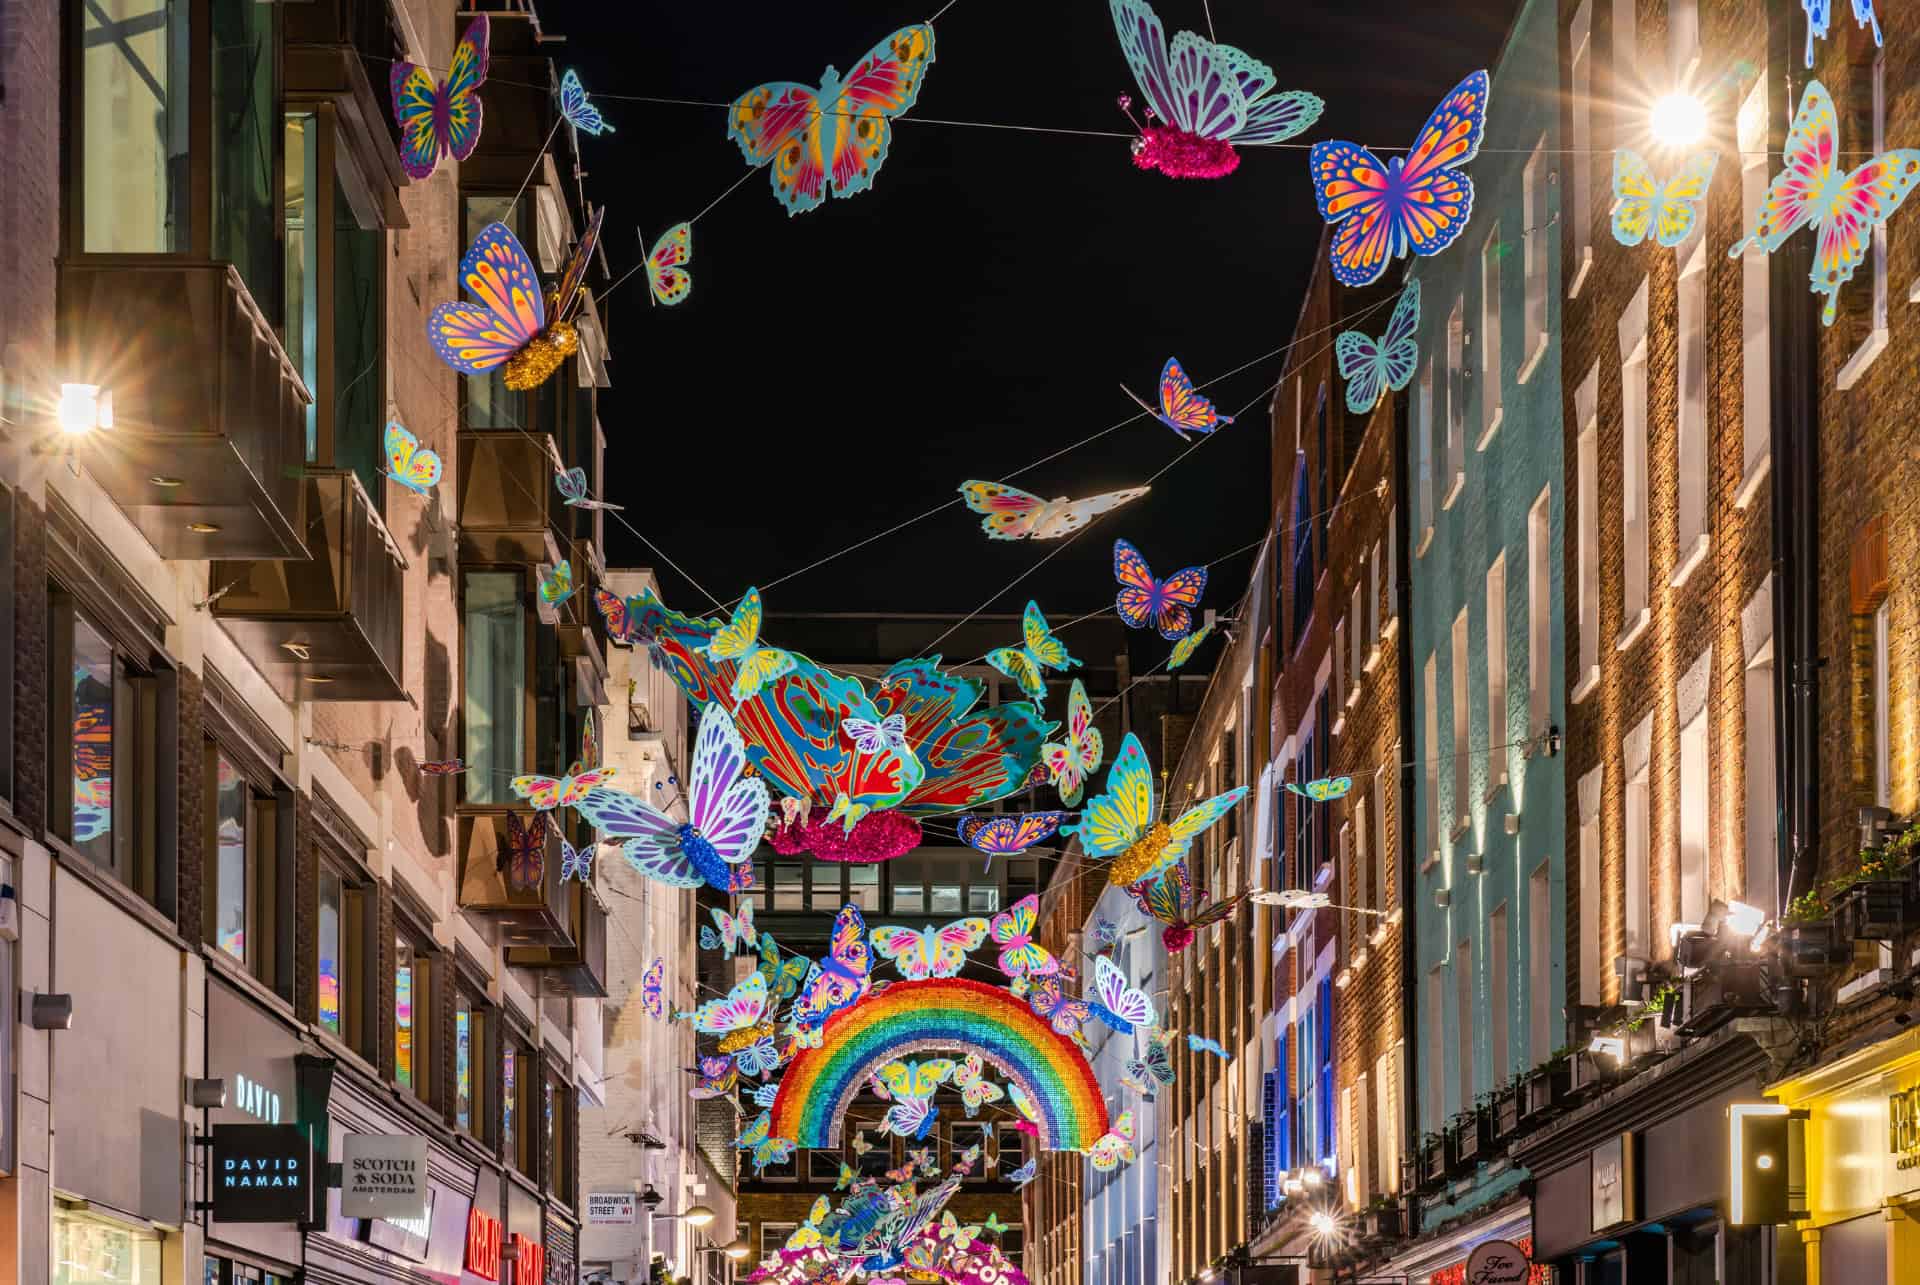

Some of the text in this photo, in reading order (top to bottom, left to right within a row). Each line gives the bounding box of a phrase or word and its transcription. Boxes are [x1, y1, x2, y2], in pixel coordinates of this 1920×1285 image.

[236, 1073, 281, 1124] DAVID
[225, 1159, 297, 1170] DAVID
[353, 1158, 416, 1171] SCOTCH
[225, 1176, 298, 1186] NAMAN
[370, 1173, 415, 1185] SODA
[352, 1185, 416, 1193] AMSTERDAM
[589, 1196, 631, 1204] BROADWICK
[590, 1206, 633, 1215] STREET W1
[469, 1208, 502, 1281] REPLAY
[1484, 1256, 1513, 1270] Too
